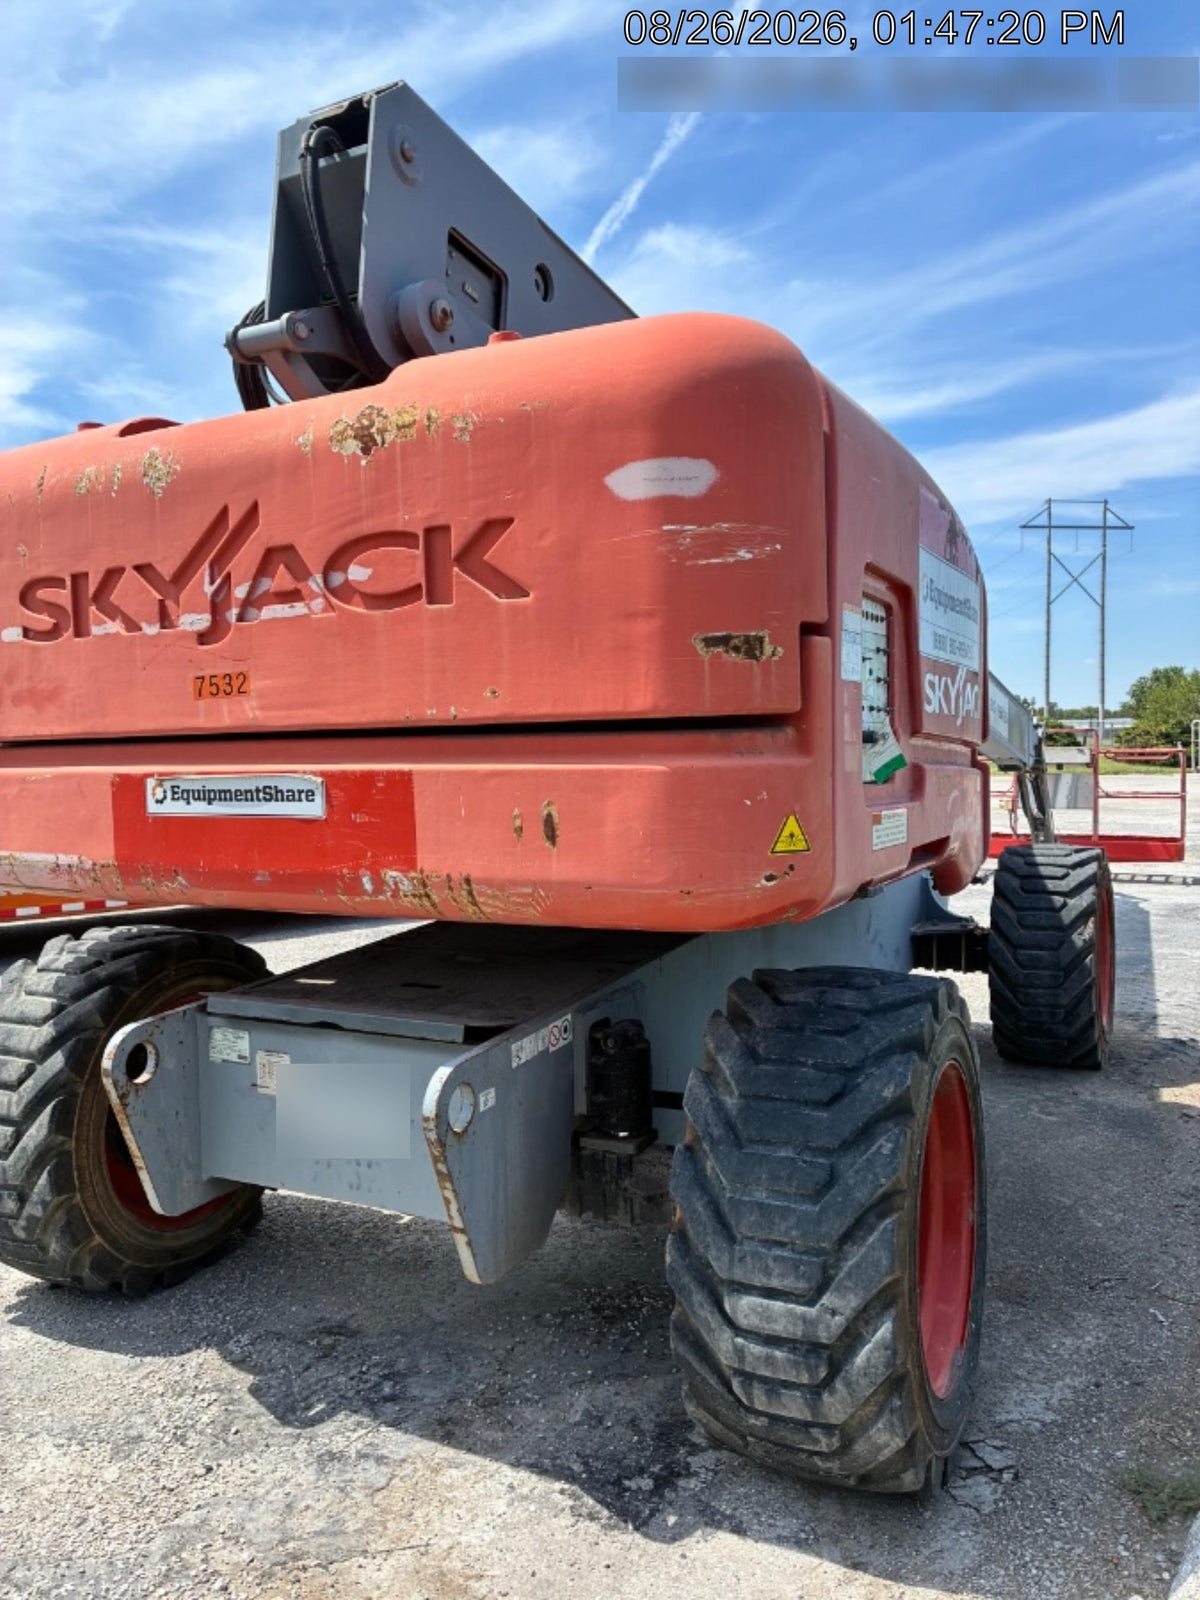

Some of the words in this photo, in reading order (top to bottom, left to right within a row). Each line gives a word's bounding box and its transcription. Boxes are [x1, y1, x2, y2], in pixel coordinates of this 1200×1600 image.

[18, 500, 533, 647] SKYJACK
[195, 671, 248, 698] 7532
[170, 785, 315, 806] EquipmentShare
